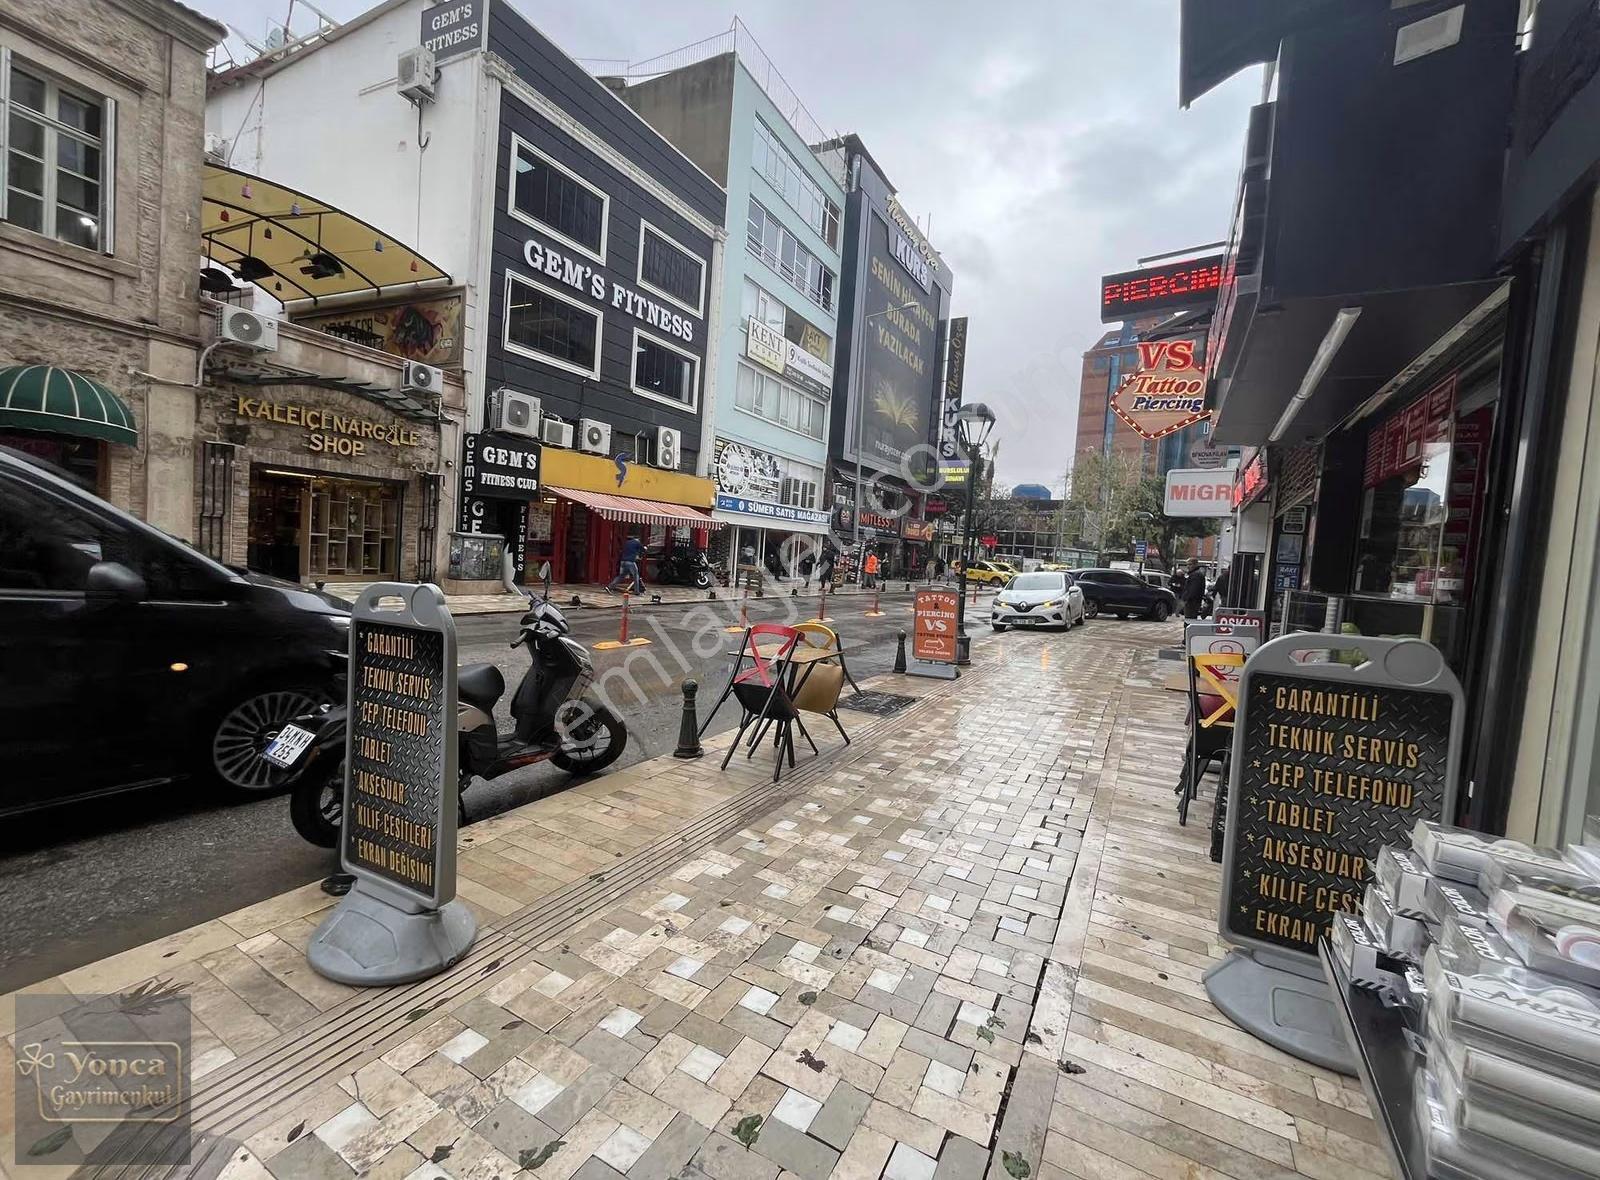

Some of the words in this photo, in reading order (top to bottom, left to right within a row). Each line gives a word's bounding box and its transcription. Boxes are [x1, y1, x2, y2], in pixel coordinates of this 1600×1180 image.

[432, 4, 472, 30] GEM'S
[425, 23, 478, 52] FITNESS
[896, 234, 928, 287] KURS
[524, 240, 605, 300] GEM'S
[611, 282, 693, 342] FITNESS
[1105, 266, 1219, 305] PIERCIN
[752, 322, 783, 352] KENT
[886, 301, 920, 346] BURADA
[878, 324, 924, 376] YAZILACAK
[1137, 340, 1194, 371] VS
[1135, 375, 1202, 395] Tattoo
[1132, 395, 1203, 413] Piercing
[310, 433, 365, 456] SHOP
[482, 446, 537, 470] GEM'S
[481, 472, 516, 488] FITNESS
[516, 477, 537, 491] CLUB
[1170, 484, 1231, 501] MiGR
[462, 496, 470, 531] FITN
[472, 500, 485, 534] GE
[748, 501, 774, 514] SÜMER
[775, 506, 796, 520] SATIŞ
[796, 510, 829, 523] MAĞAZASI
[918, 594, 956, 606] TATTOO
[924, 619, 948, 632] VS
[367, 632, 413, 660] GARANTİLİ
[363, 666, 395, 693] TEKNİK
[397, 673, 431, 700] SERVİS
[362, 701, 379, 724] CEP
[382, 705, 427, 737] TELEFONU
[1275, 686, 1379, 722] GARANTİLİ
[360, 736, 392, 764] TABLET
[1269, 723, 1335, 756] TEKNİK
[1343, 734, 1419, 769] SERVİS
[358, 771, 405, 805] AKSESUAR
[1269, 762, 1304, 789] CEP
[1313, 769, 1412, 809] TELEFONU
[358, 805, 380, 831] KILIF
[384, 813, 431, 850] ÇEŞİTLERİ
[1267, 799, 1335, 834] TABLET
[358, 838, 386, 868] EKRAN
[1262, 837, 1364, 880] AKSESUAR
[1259, 873, 1308, 905] KILIF
[1314, 886, 1362, 915] ÇEŞİ
[1255, 909, 1316, 945] EKRAN
[1459, 924, 1502, 961] COLOR
